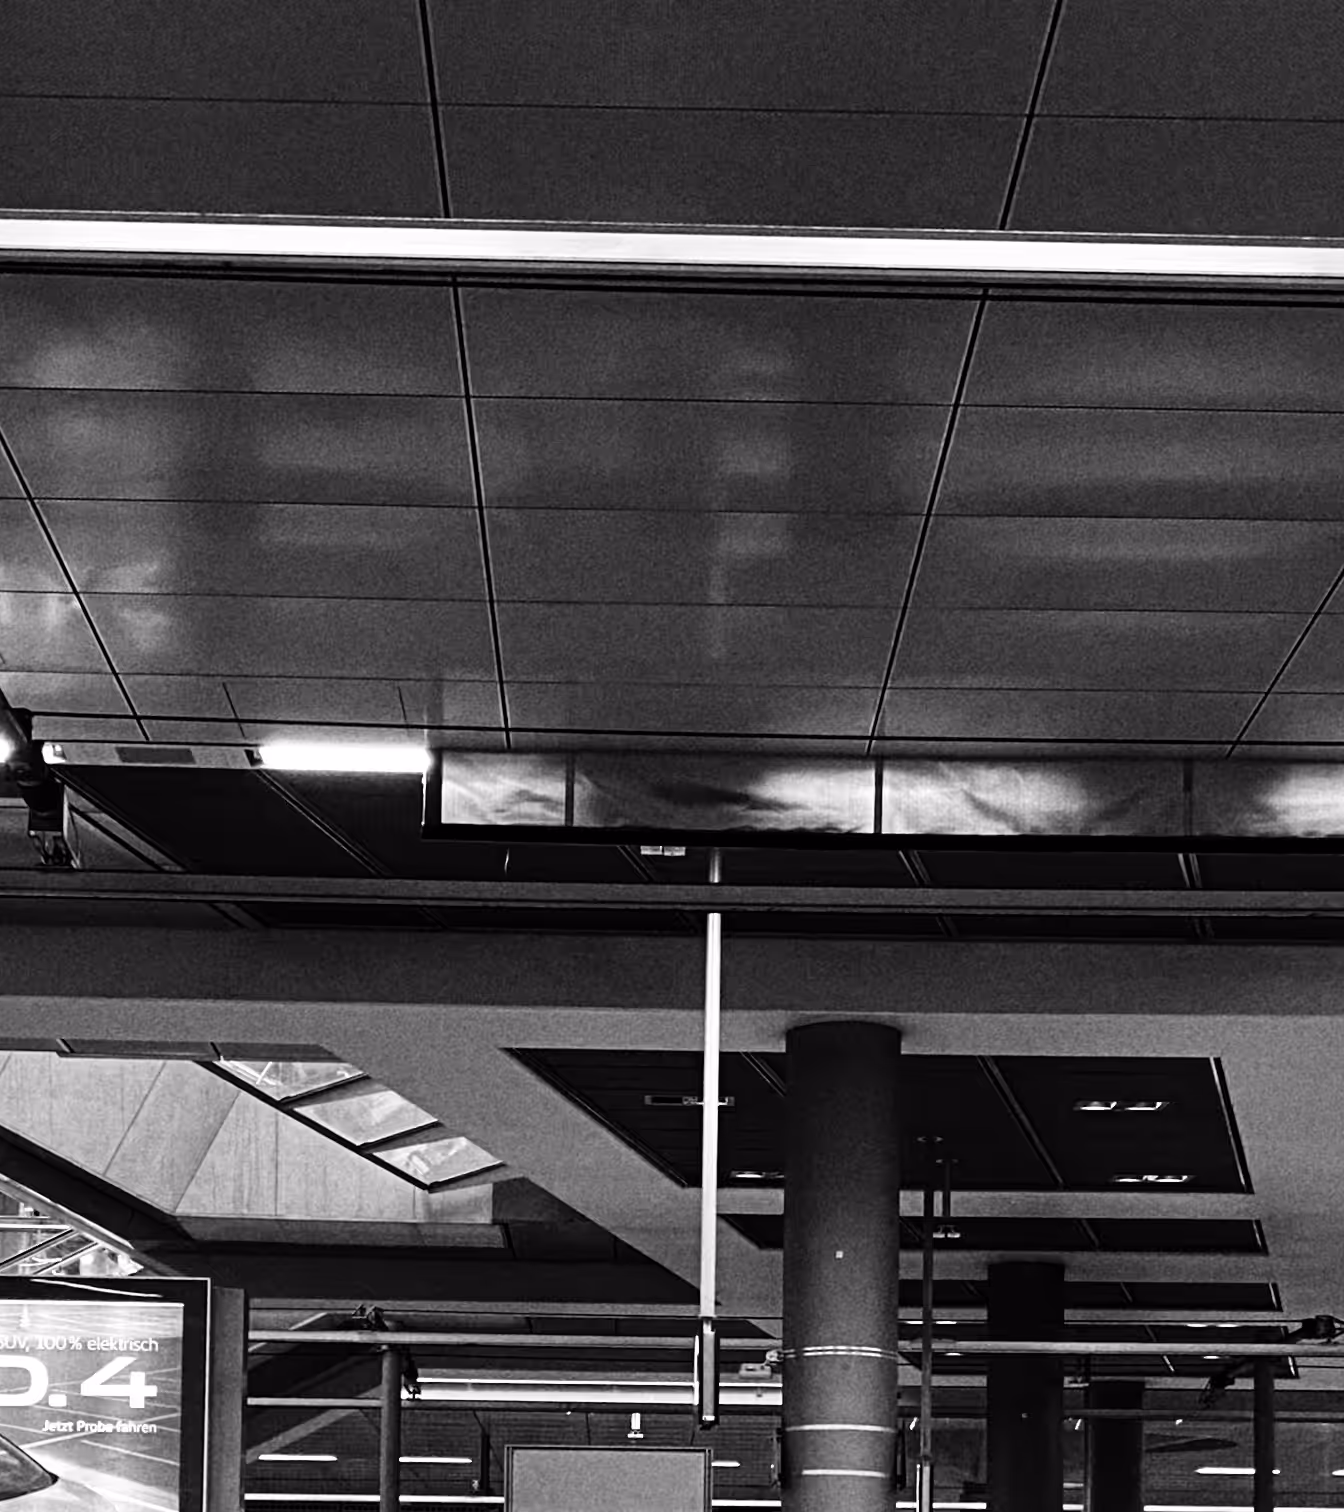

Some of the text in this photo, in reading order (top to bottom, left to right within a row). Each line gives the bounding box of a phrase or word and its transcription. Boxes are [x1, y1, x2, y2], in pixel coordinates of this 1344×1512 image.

[87, 1337, 159, 1352] elektrisch
[42, 1419, 74, 1433] Jetzt
[115, 1420, 157, 1434] fahren
